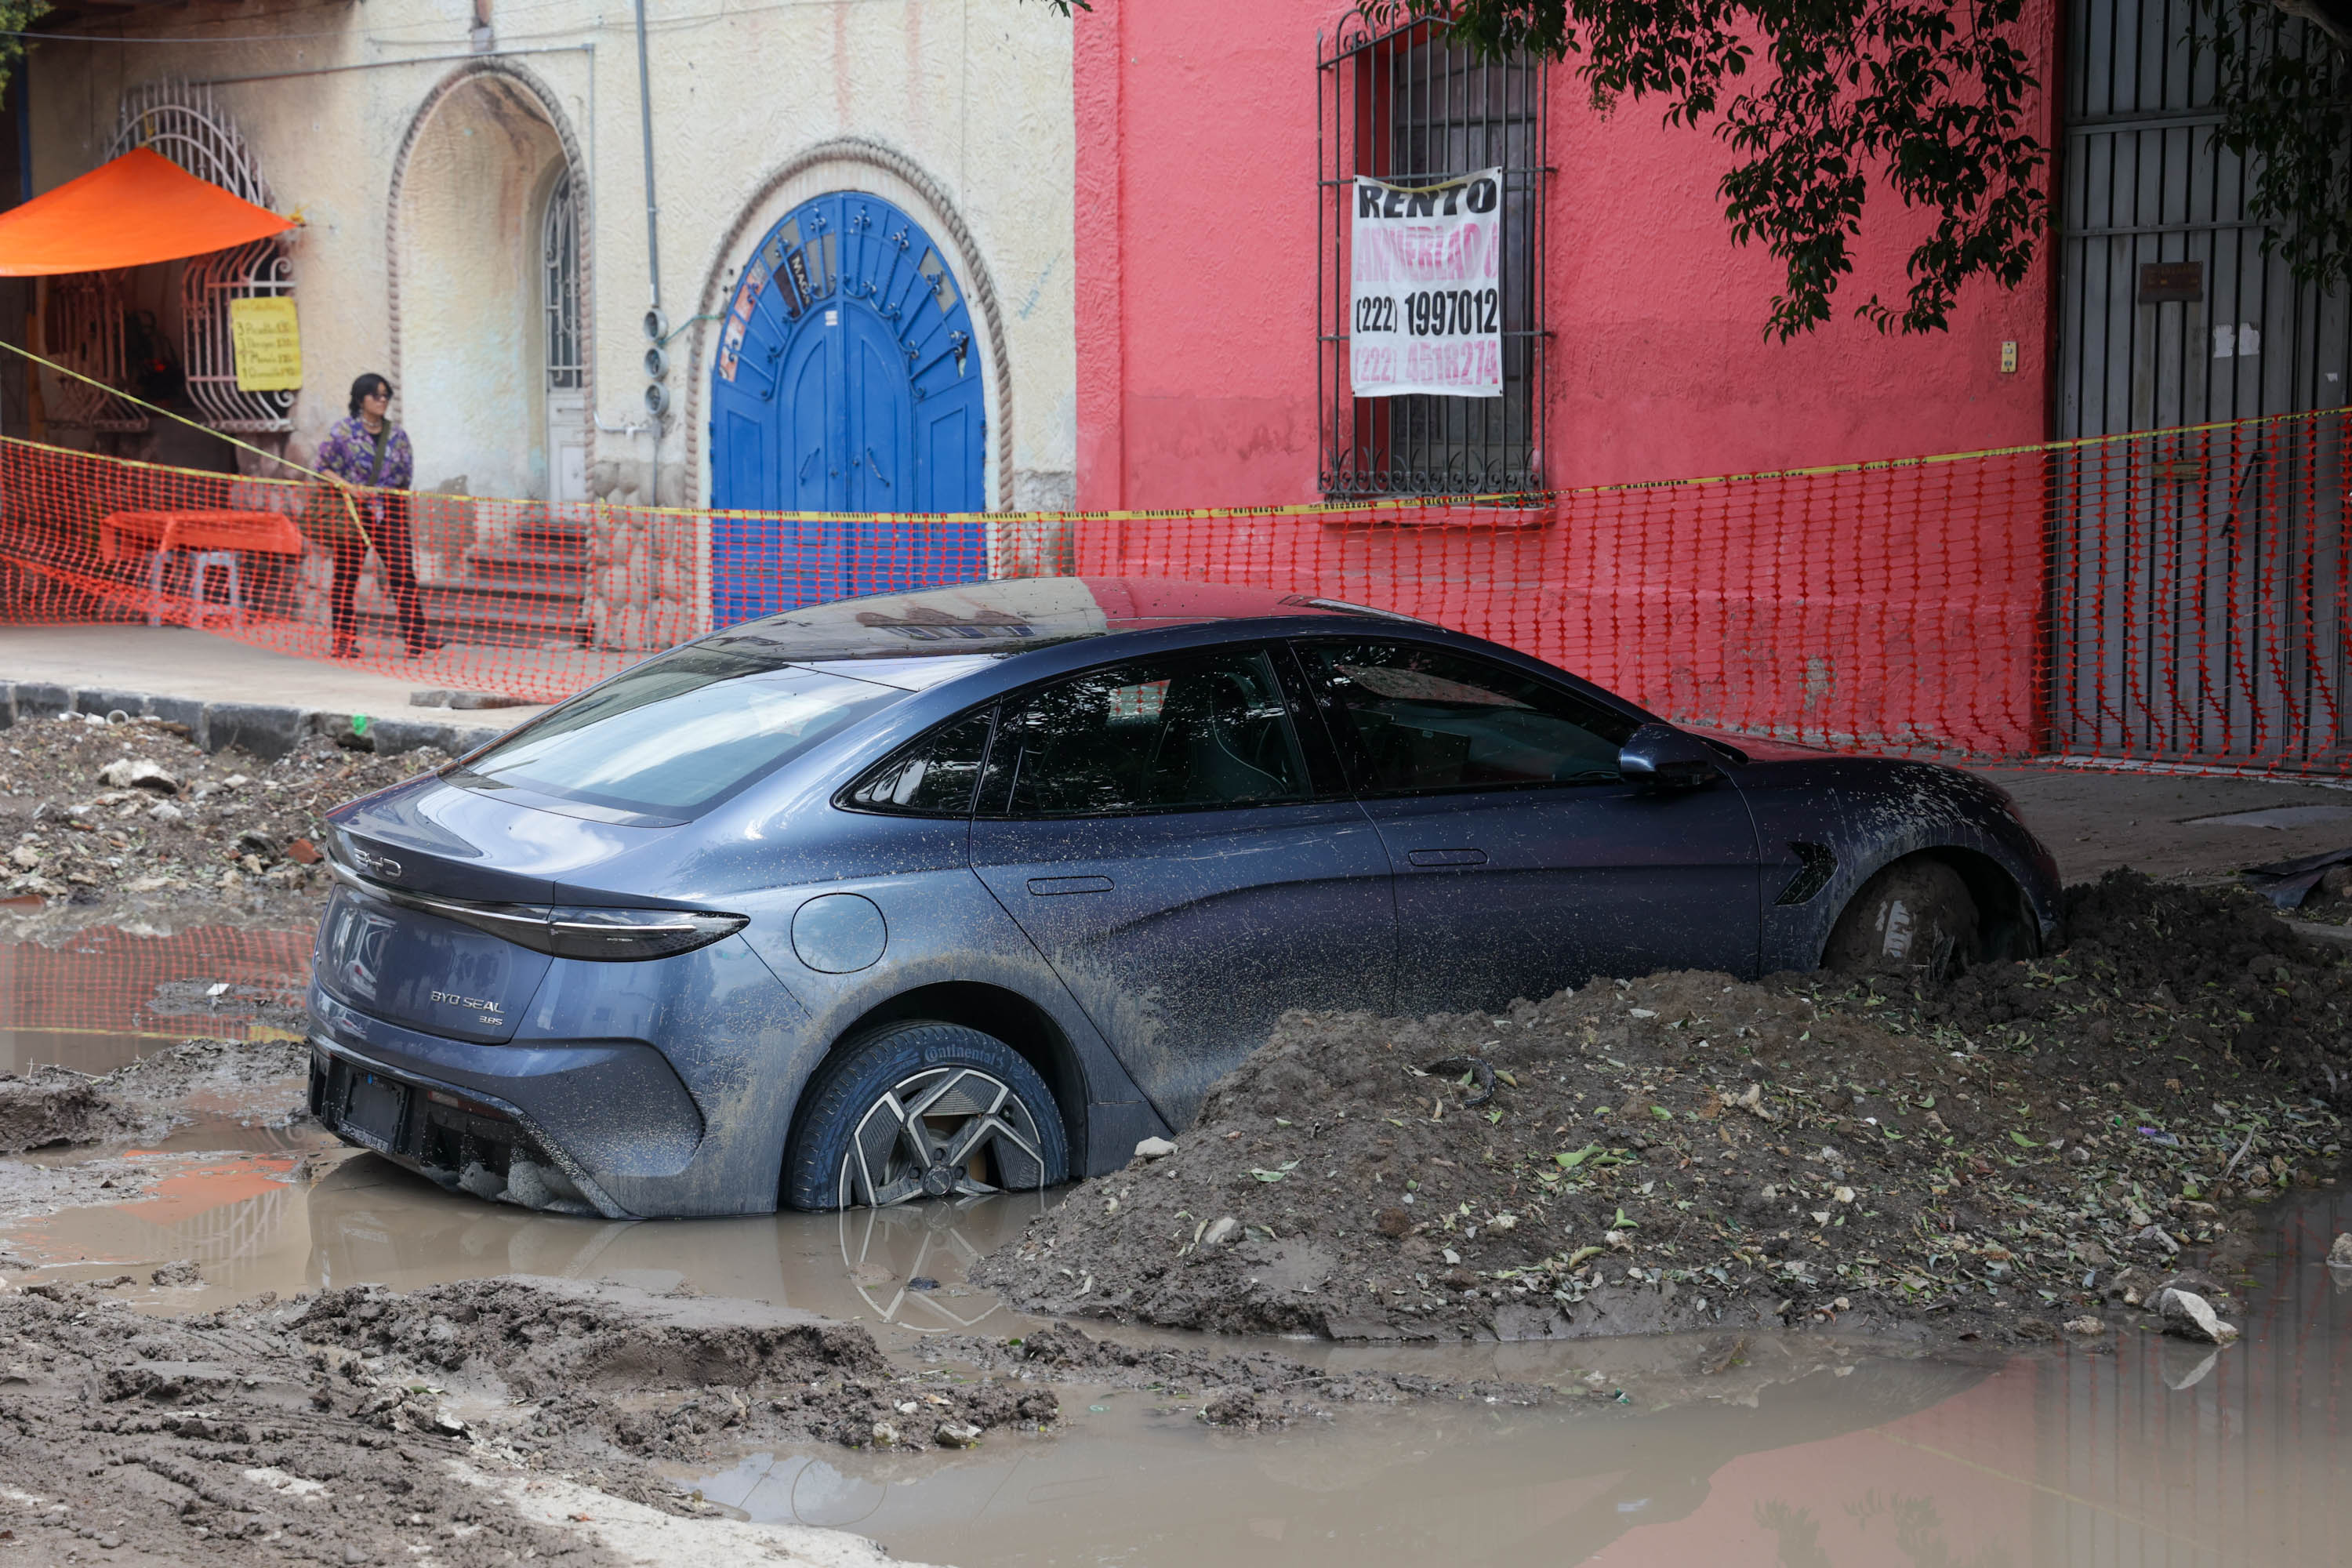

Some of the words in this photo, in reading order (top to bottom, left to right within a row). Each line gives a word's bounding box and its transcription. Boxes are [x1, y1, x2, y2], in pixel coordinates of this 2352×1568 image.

[1359, 178, 1497, 219] RENTO
[1356, 296, 1397, 333] (222)
[1405, 289, 1497, 336] 1997012
[1355, 345, 1397, 383] (222)
[354, 848, 401, 877] BYD
[430, 990, 460, 1005] BYD
[463, 996, 506, 1014] SEAL
[925, 1044, 996, 1065] Continental
